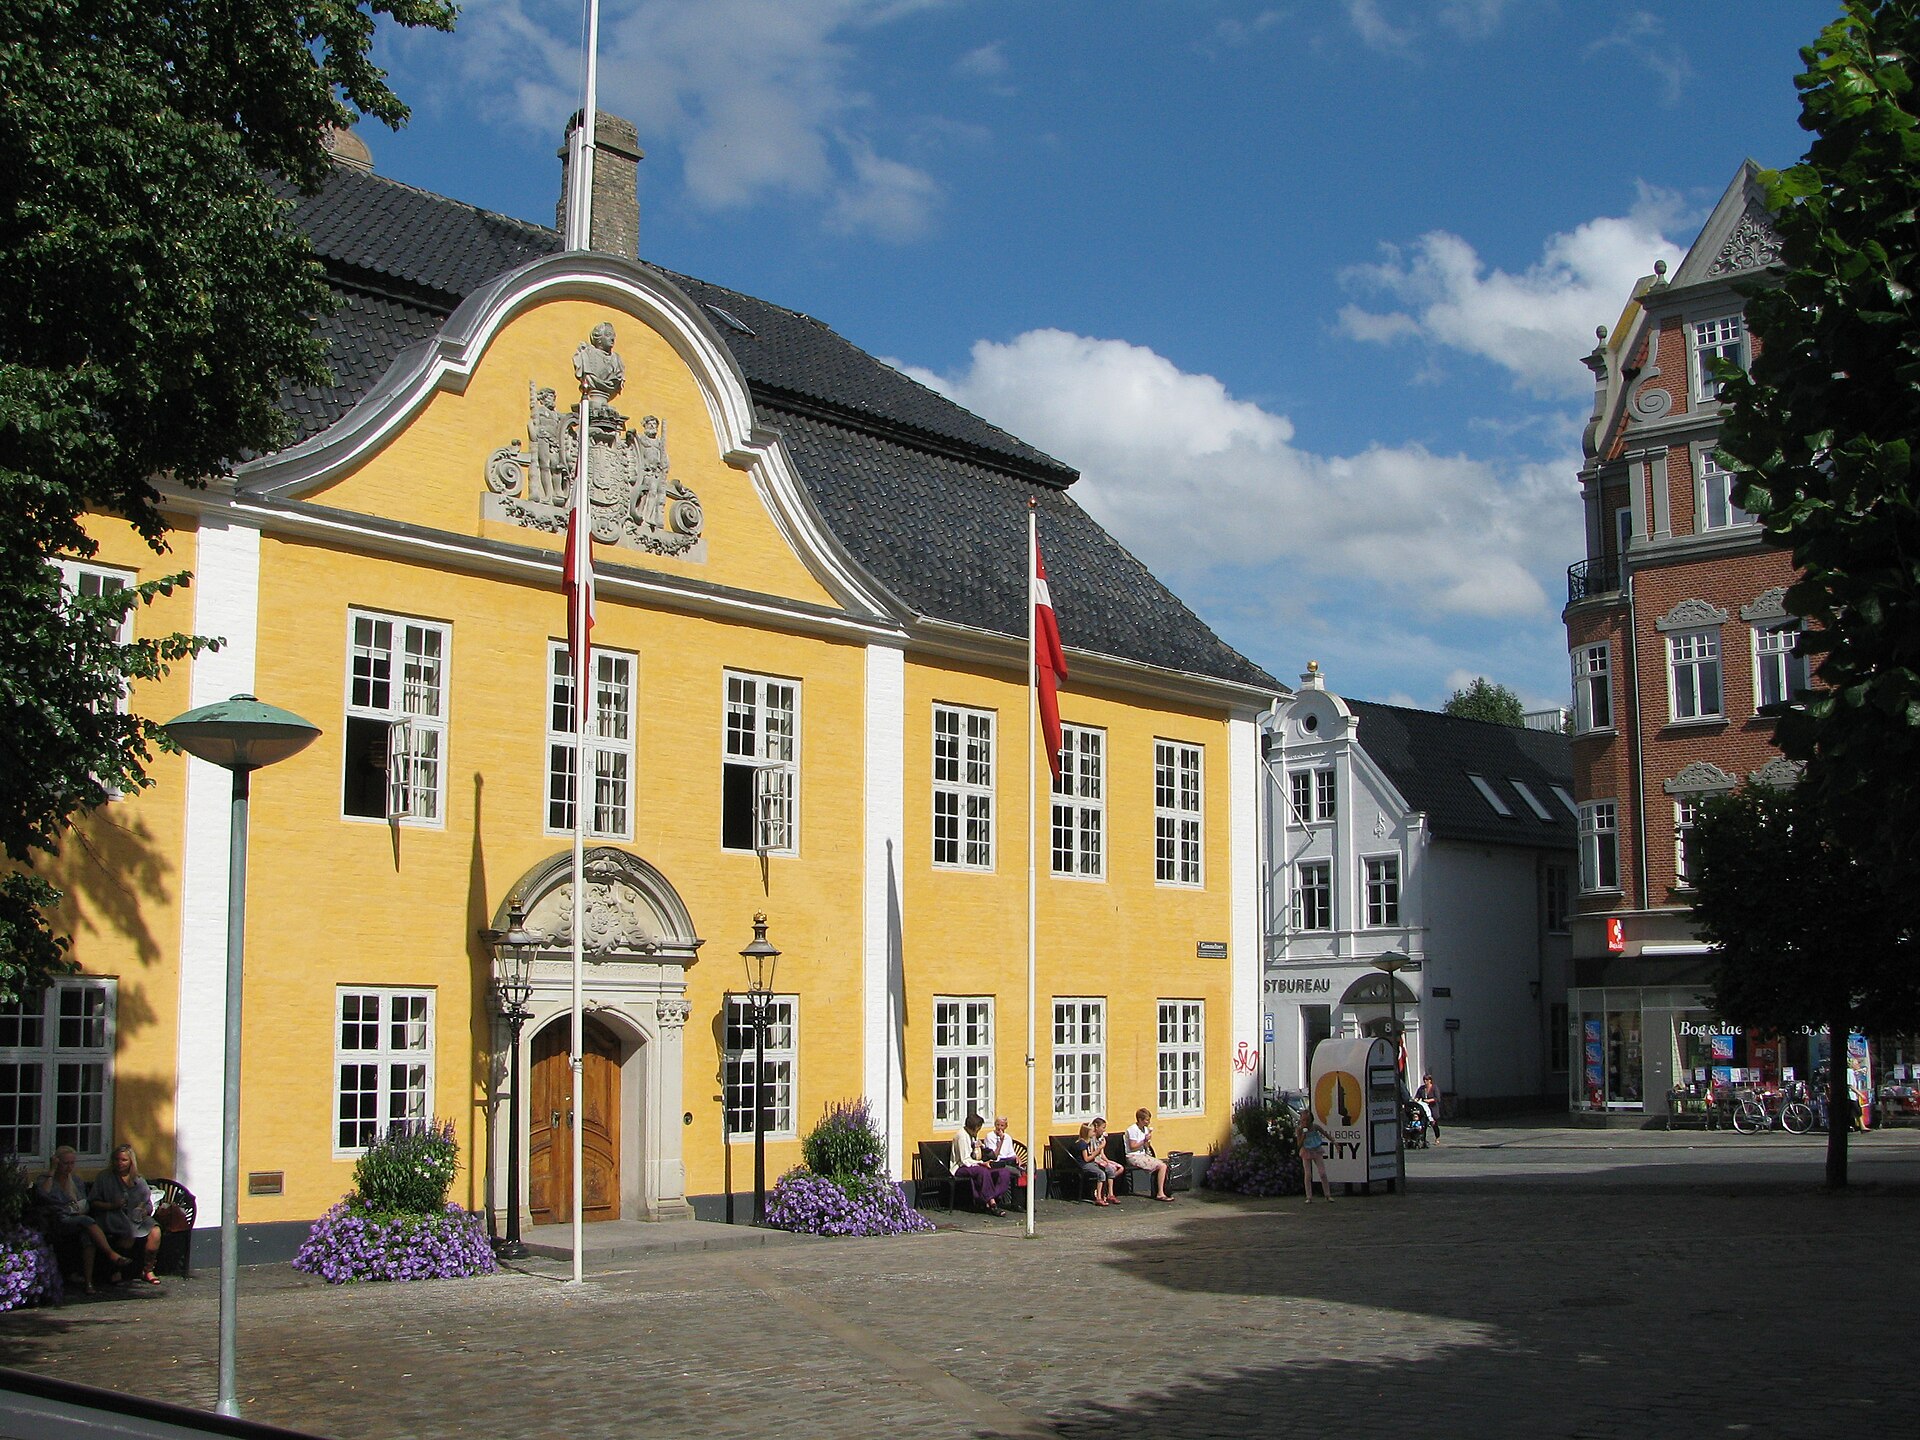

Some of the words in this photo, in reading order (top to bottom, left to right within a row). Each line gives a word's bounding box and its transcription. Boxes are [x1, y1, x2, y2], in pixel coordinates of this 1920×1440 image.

[1384, 1022, 1392, 1033] 8
[1679, 1021, 1706, 1037] Bog
[1708, 1024, 1719, 1035] &
